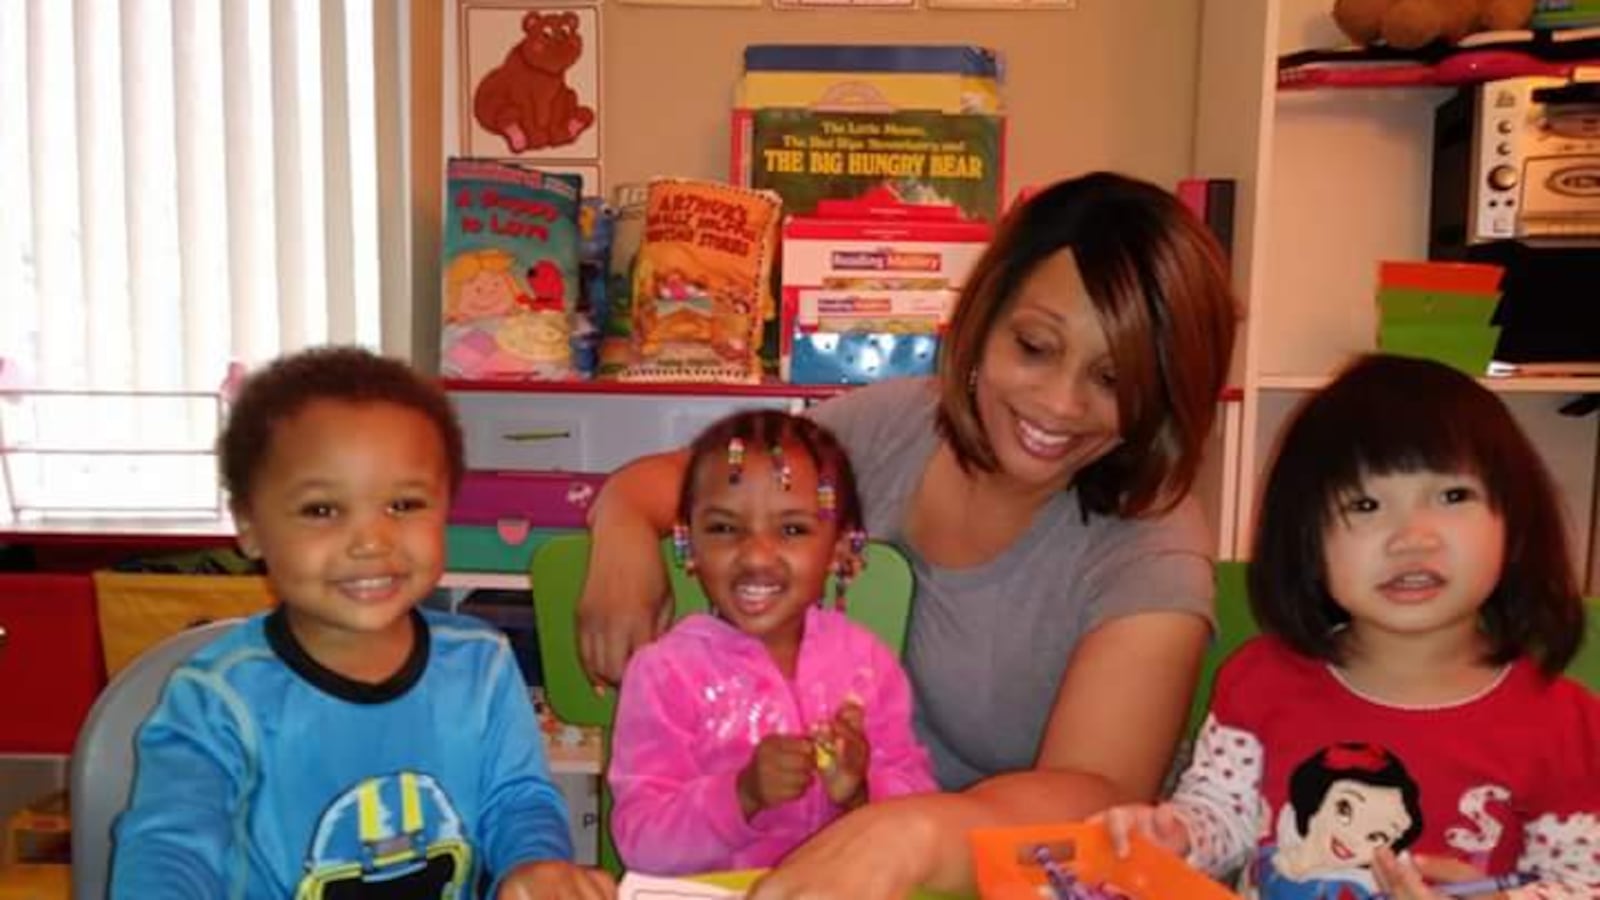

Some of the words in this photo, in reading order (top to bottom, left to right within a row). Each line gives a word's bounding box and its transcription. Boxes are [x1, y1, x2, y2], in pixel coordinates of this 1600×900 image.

[764, 150, 804, 173] THE
[809, 151, 843, 175] BIG
[848, 152, 925, 176] HUNGRY
[929, 155, 983, 179] BEAR
[1445, 785, 1512, 851] S
